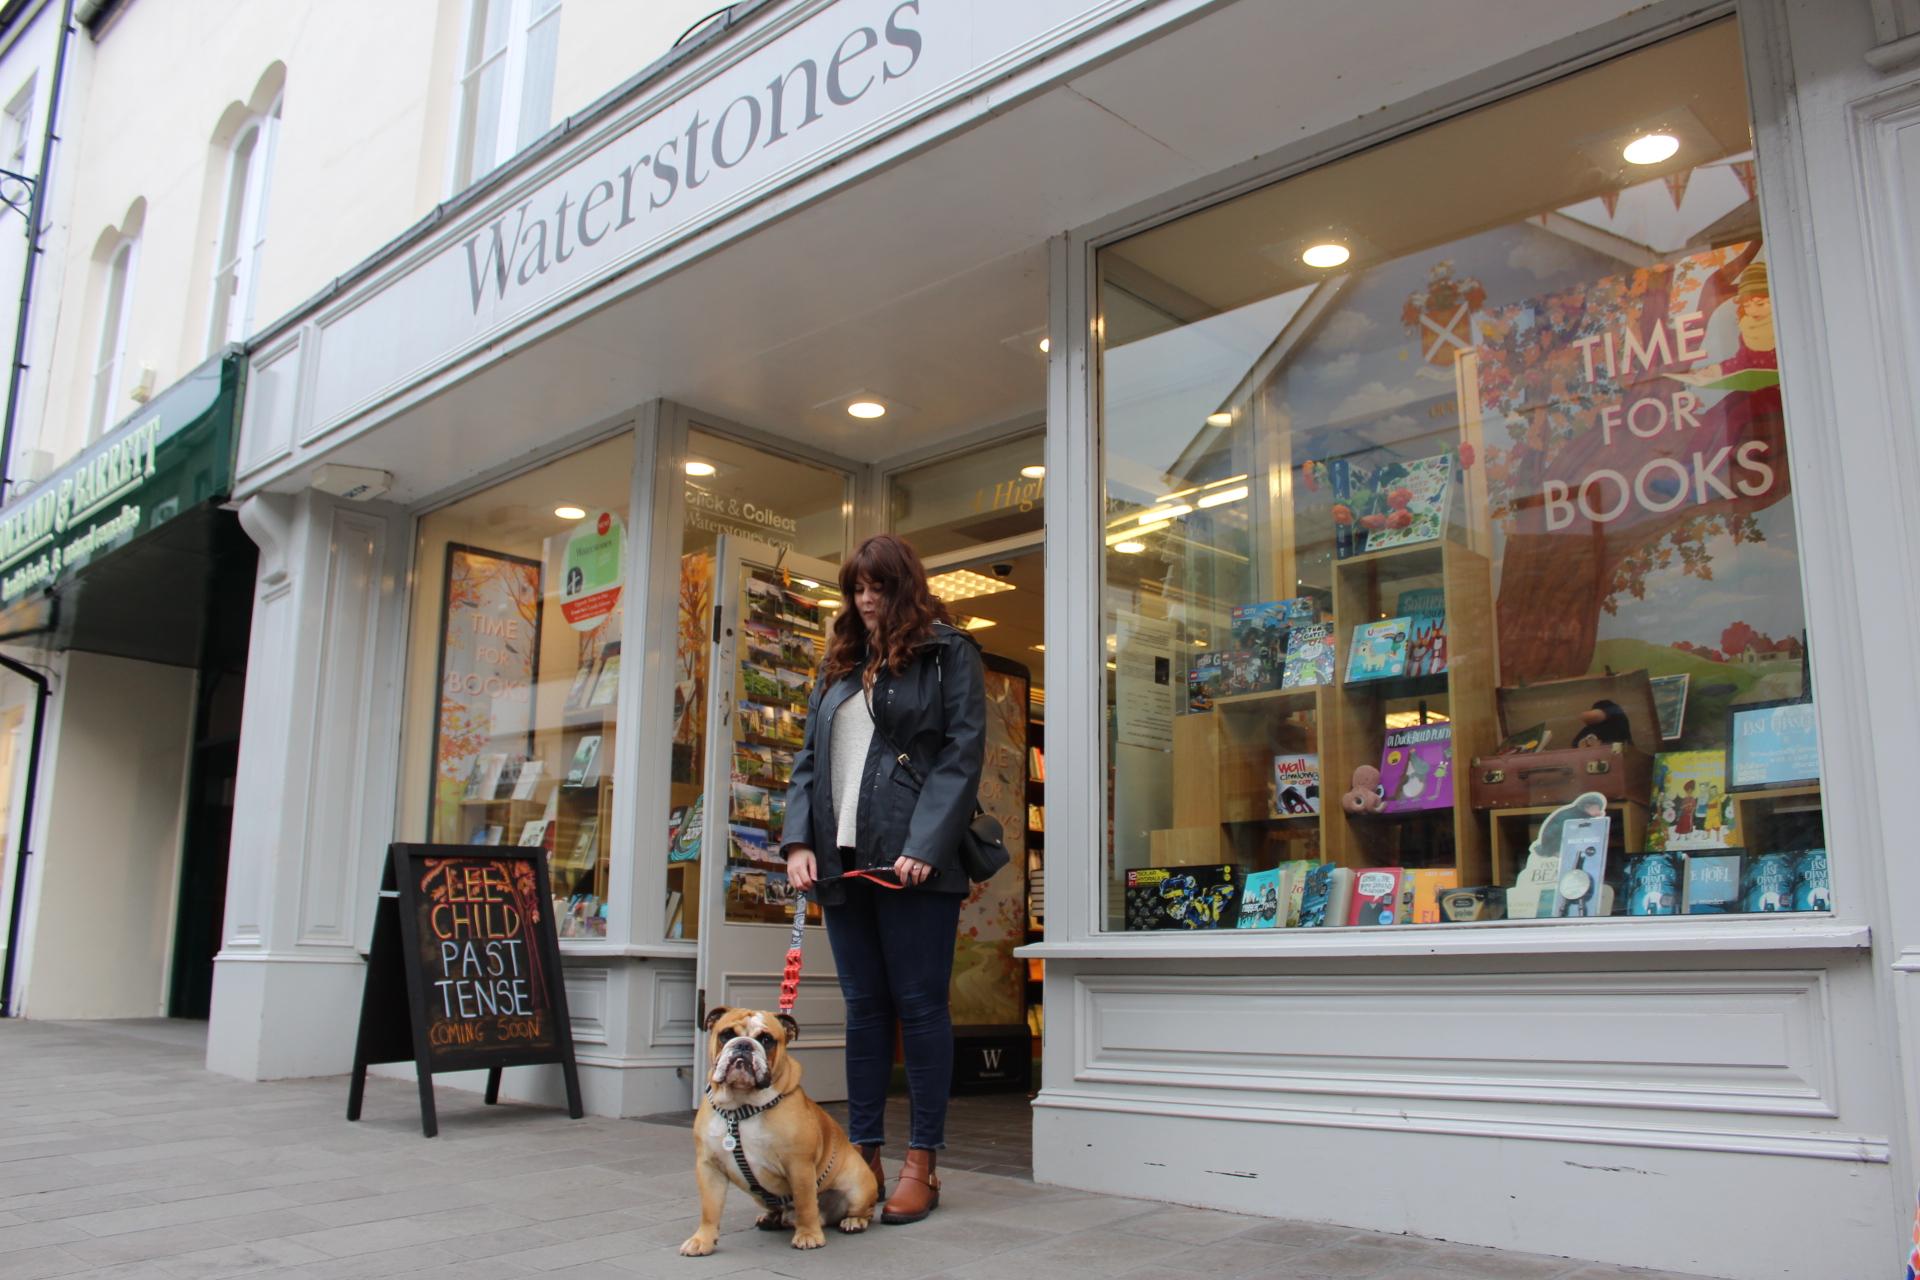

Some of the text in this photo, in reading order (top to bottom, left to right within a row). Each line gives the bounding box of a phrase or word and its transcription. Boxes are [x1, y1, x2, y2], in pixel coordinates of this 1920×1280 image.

[463, 0, 922, 315] Waterstones
[1573, 310, 1707, 384] TIME
[1600, 390, 1700, 446] FOR
[55, 478, 73, 534] &
[73, 414, 161, 516] BARRETT
[1543, 440, 1774, 532] BOOKS
[685, 491, 797, 531] Click & Collect
[472, 614, 518, 639] TIME
[476, 647, 509, 665] FOR
[448, 671, 529, 703] BOOKS
[1278, 758, 1306, 773] wall
[444, 867, 502, 902] LEE
[431, 903, 520, 940] CHILD
[441, 939, 522, 978] PAST
[434, 979, 533, 1018] TENSE
[430, 1017, 541, 1045] COMING SOON
[983, 1049, 1002, 1070] W
